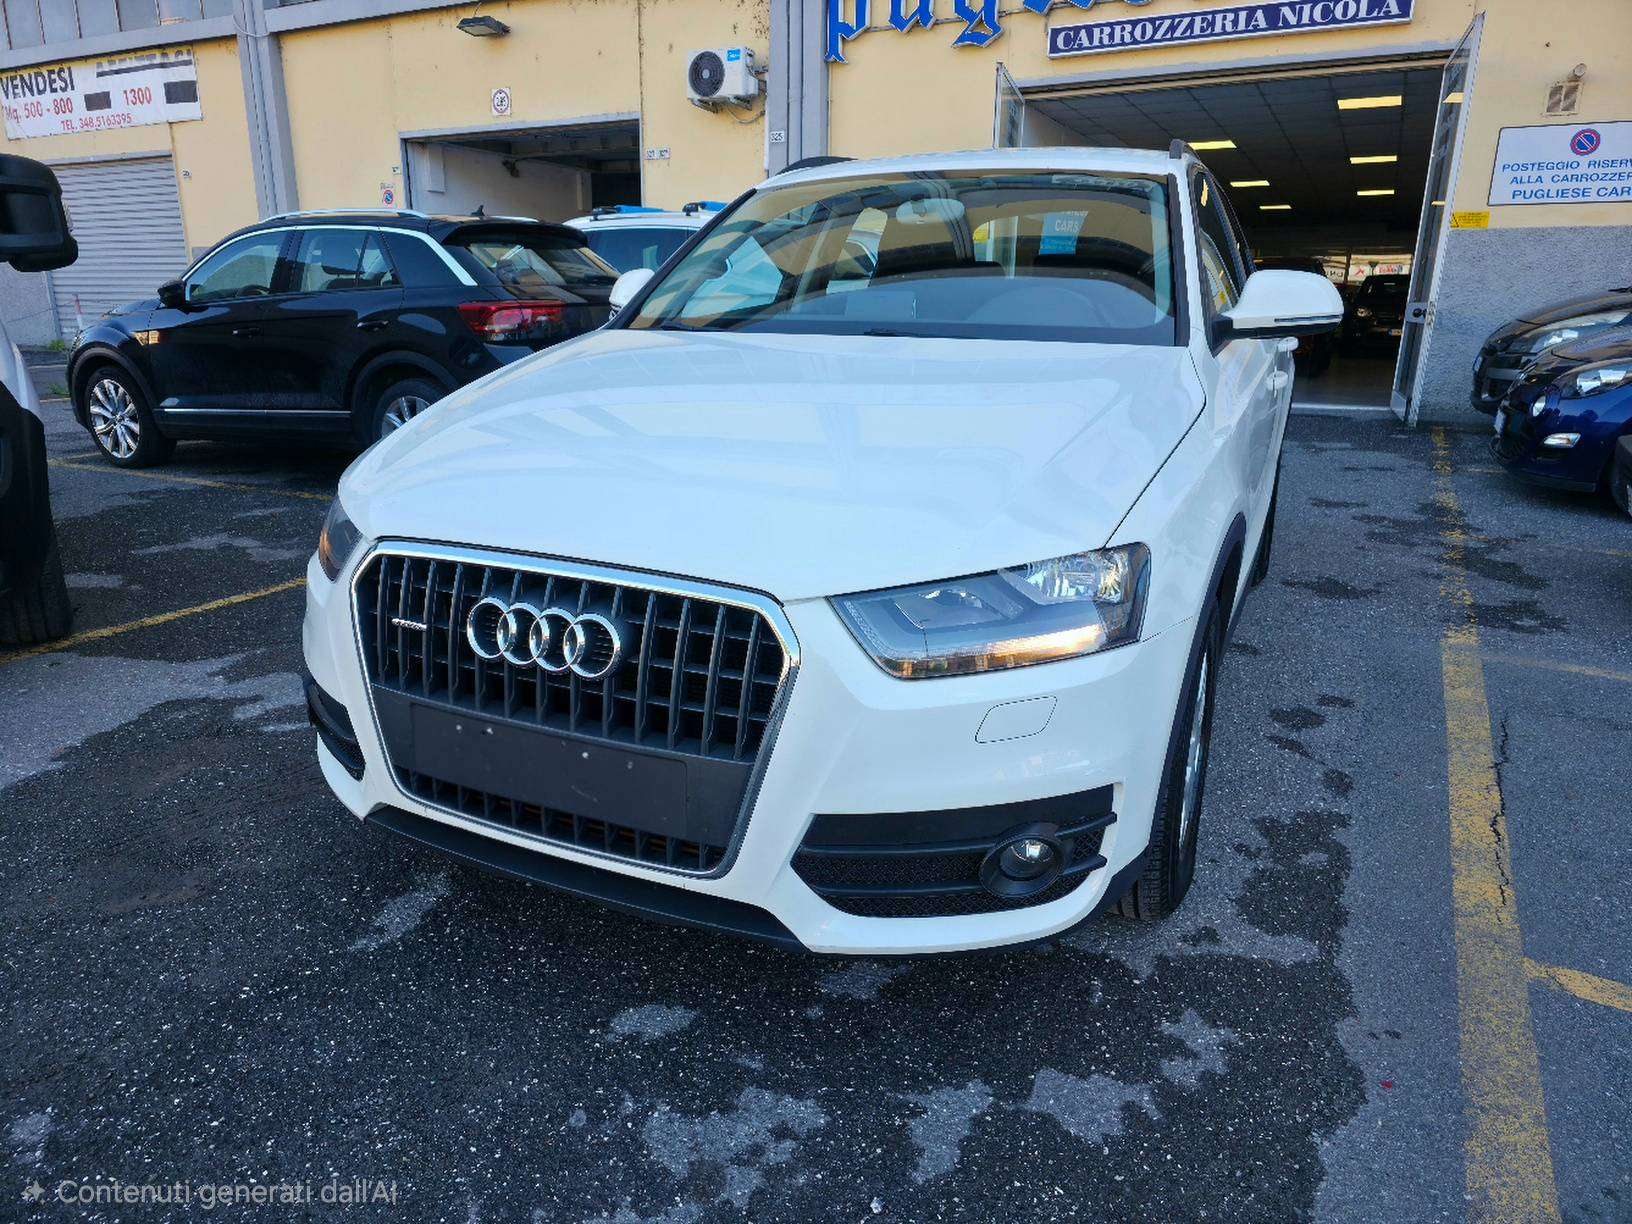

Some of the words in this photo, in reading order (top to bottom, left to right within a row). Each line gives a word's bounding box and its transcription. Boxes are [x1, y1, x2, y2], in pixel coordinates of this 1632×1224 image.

[1055, 9, 1270, 51] CARROZZERIA
[1277, 0, 1402, 28] NICOLA
[0, 66, 75, 100] VENDESI
[23, 101, 43, 119] 500
[52, 97, 74, 116] 800
[123, 86, 153, 107] 1300
[1502, 160, 1581, 172] POSTEGGIO
[1587, 158, 1632, 169] RISER
[1510, 175, 1544, 185] ALLA
[1511, 187, 1592, 200] PUGLIESE
[1597, 186, 1632, 198] CAR
